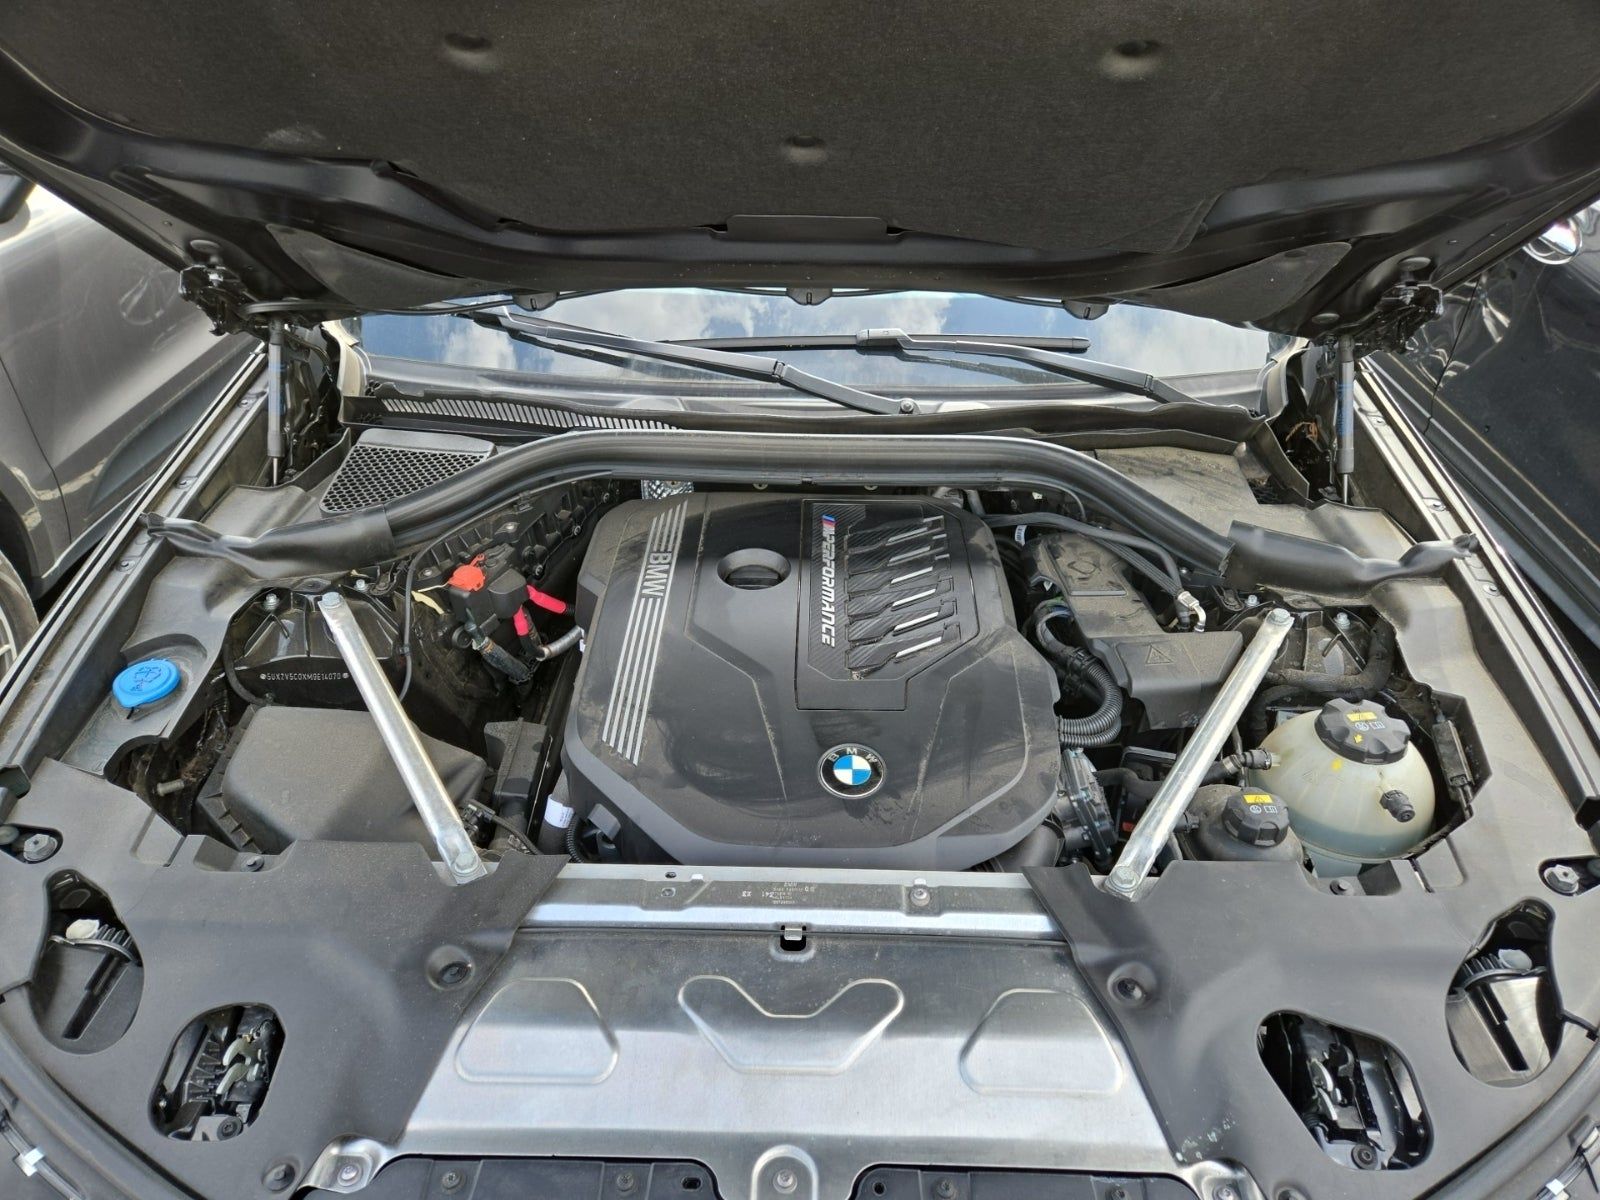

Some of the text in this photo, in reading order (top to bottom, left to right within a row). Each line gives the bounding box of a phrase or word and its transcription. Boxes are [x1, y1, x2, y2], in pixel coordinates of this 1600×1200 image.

[641, 553, 671, 596] BMW
[821, 535, 835, 648] PERFORMANCE
[828, 747, 878, 763] BMW
